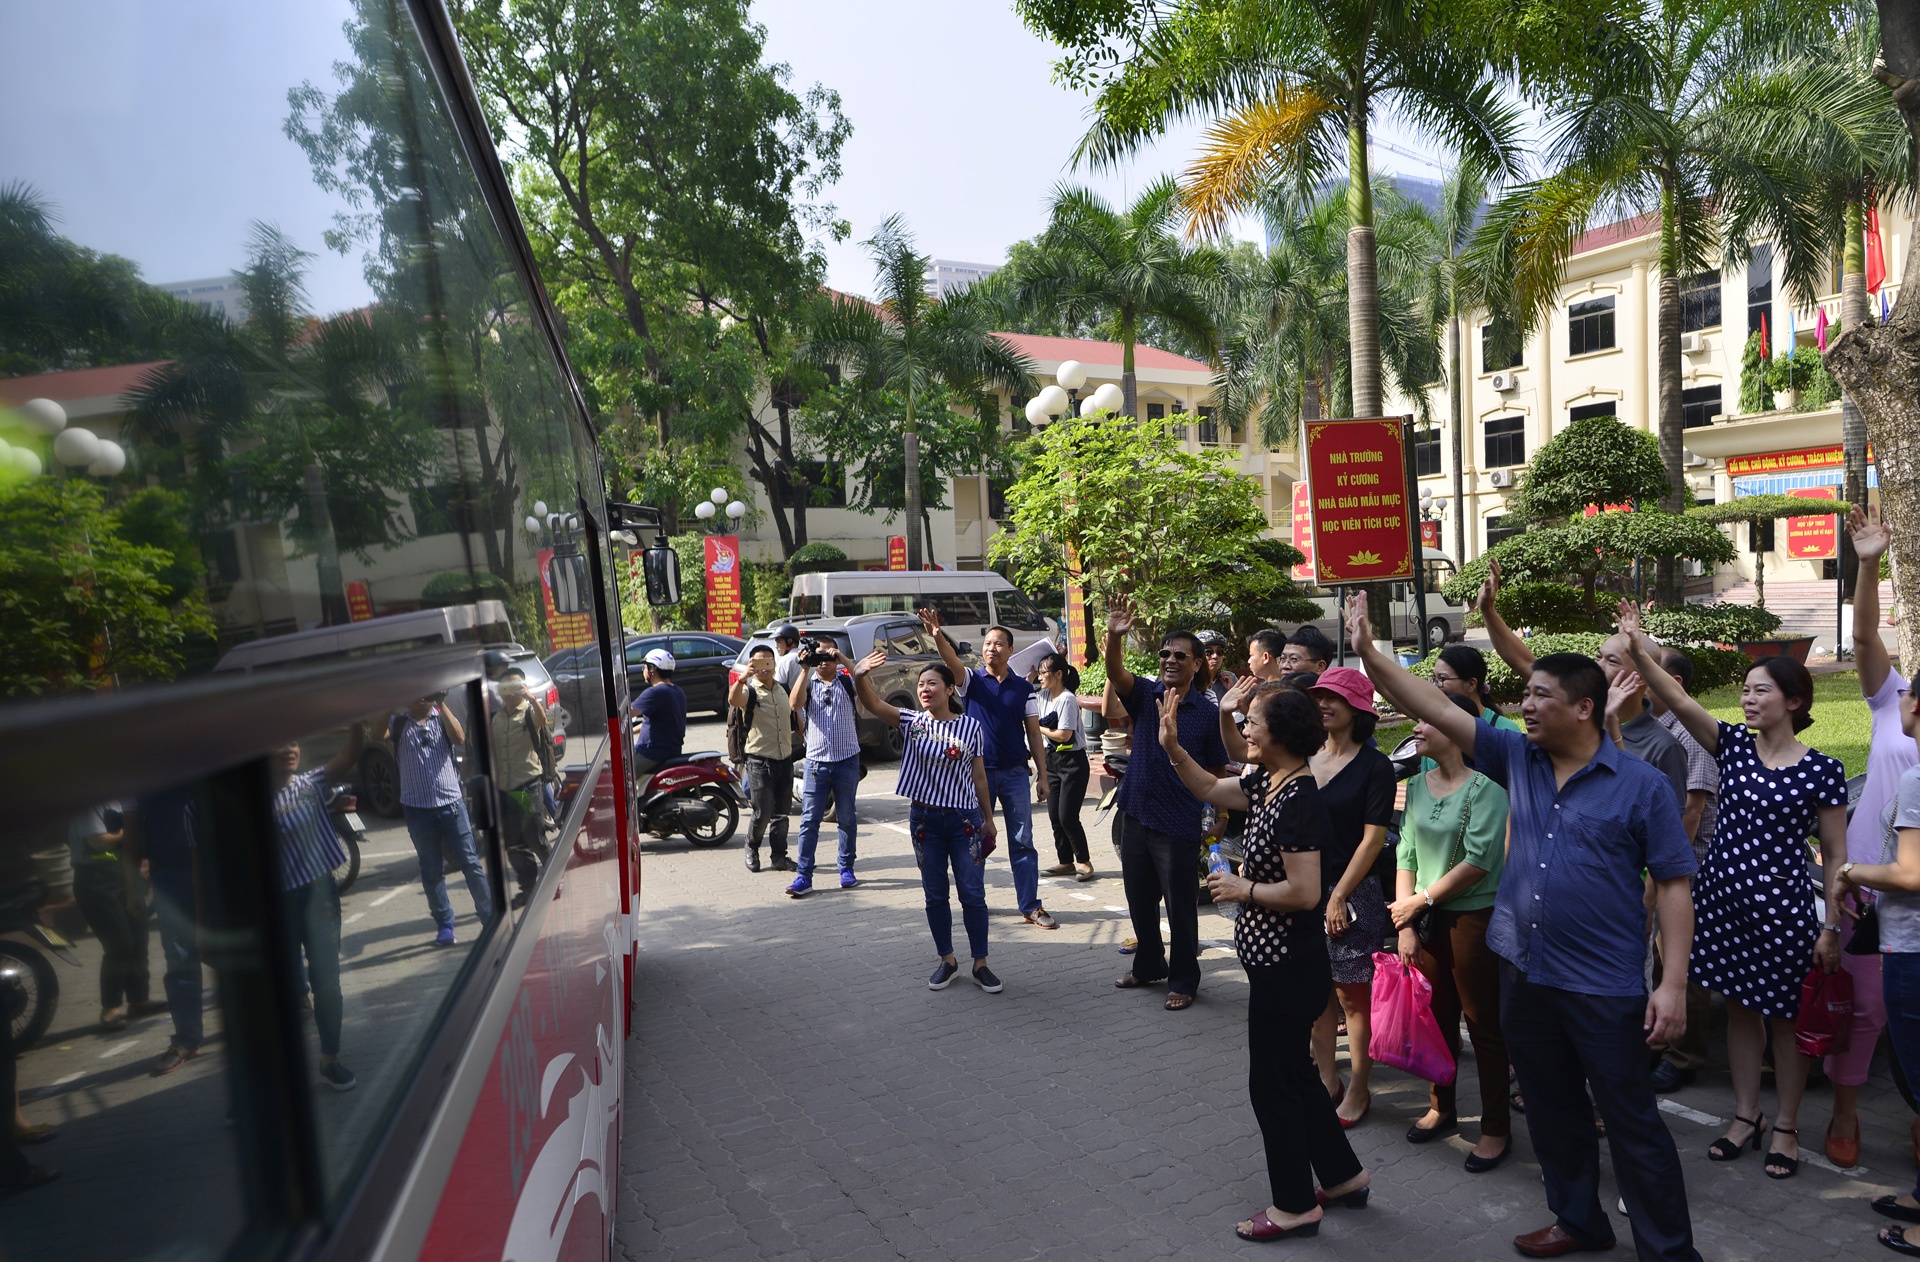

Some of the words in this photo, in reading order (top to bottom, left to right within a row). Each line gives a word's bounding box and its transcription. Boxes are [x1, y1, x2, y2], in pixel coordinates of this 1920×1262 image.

[1329, 451, 1348, 464] NHÀ
[1350, 450, 1383, 463] TRƯỜNG
[1807, 452, 1825, 465] TRÁCH
[1337, 472, 1349, 486] KỶ
[1350, 473, 1379, 485] CƯƠNG
[1318, 495, 1336, 509] NHÀ
[1338, 494, 1358, 508] GIÁO
[1360, 491, 1380, 506] MẪU
[1382, 493, 1401, 507] MỰC
[1322, 520, 1340, 533] HỌC
[1341, 518, 1361, 531] VIÊN
[1364, 517, 1382, 530] TÍCH
[1384, 516, 1401, 529] CỰC
